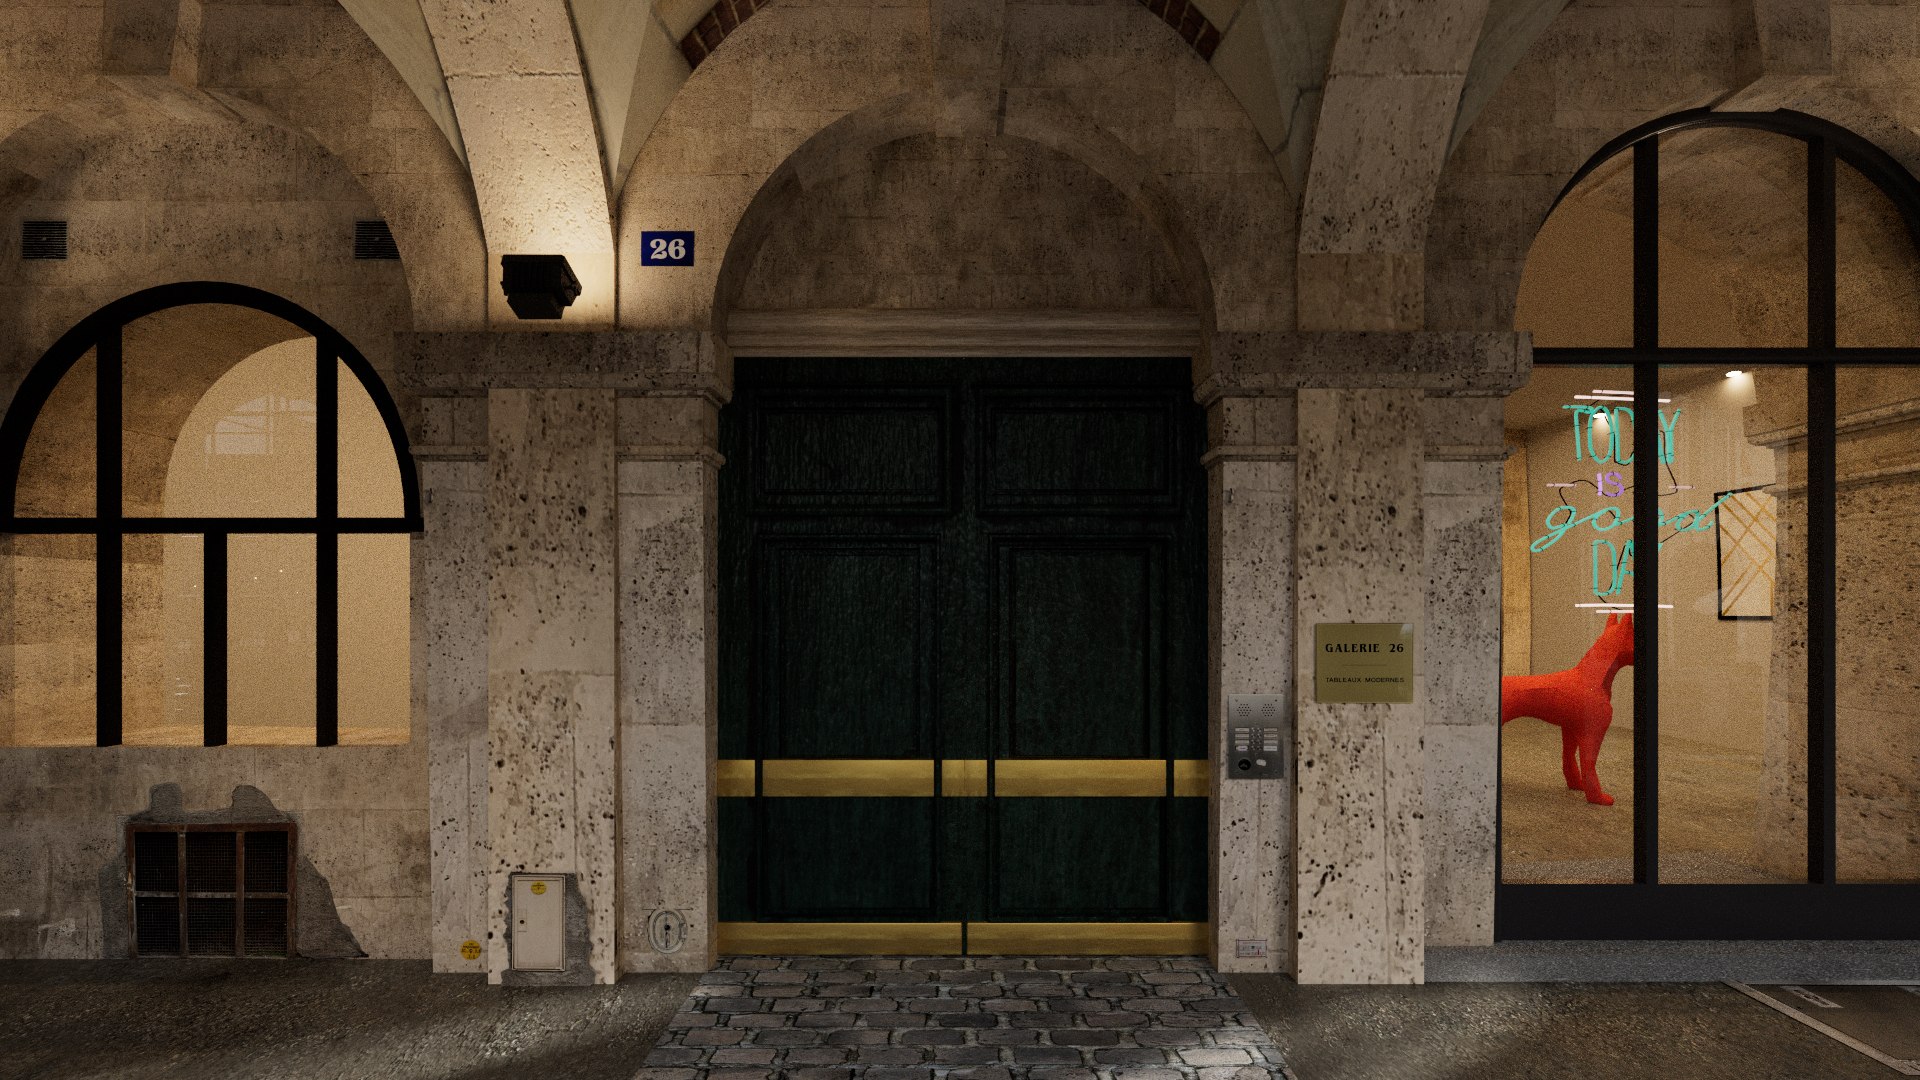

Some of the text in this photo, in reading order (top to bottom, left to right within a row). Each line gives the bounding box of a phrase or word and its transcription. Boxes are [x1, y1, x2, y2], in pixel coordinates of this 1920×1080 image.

[649, 238, 687, 260] 26
[1562, 404, 1682, 464] TODY
[1596, 471, 1625, 497] IS
[1592, 539, 1664, 597] DA
[1325, 643, 1404, 653] GALERIE 26
